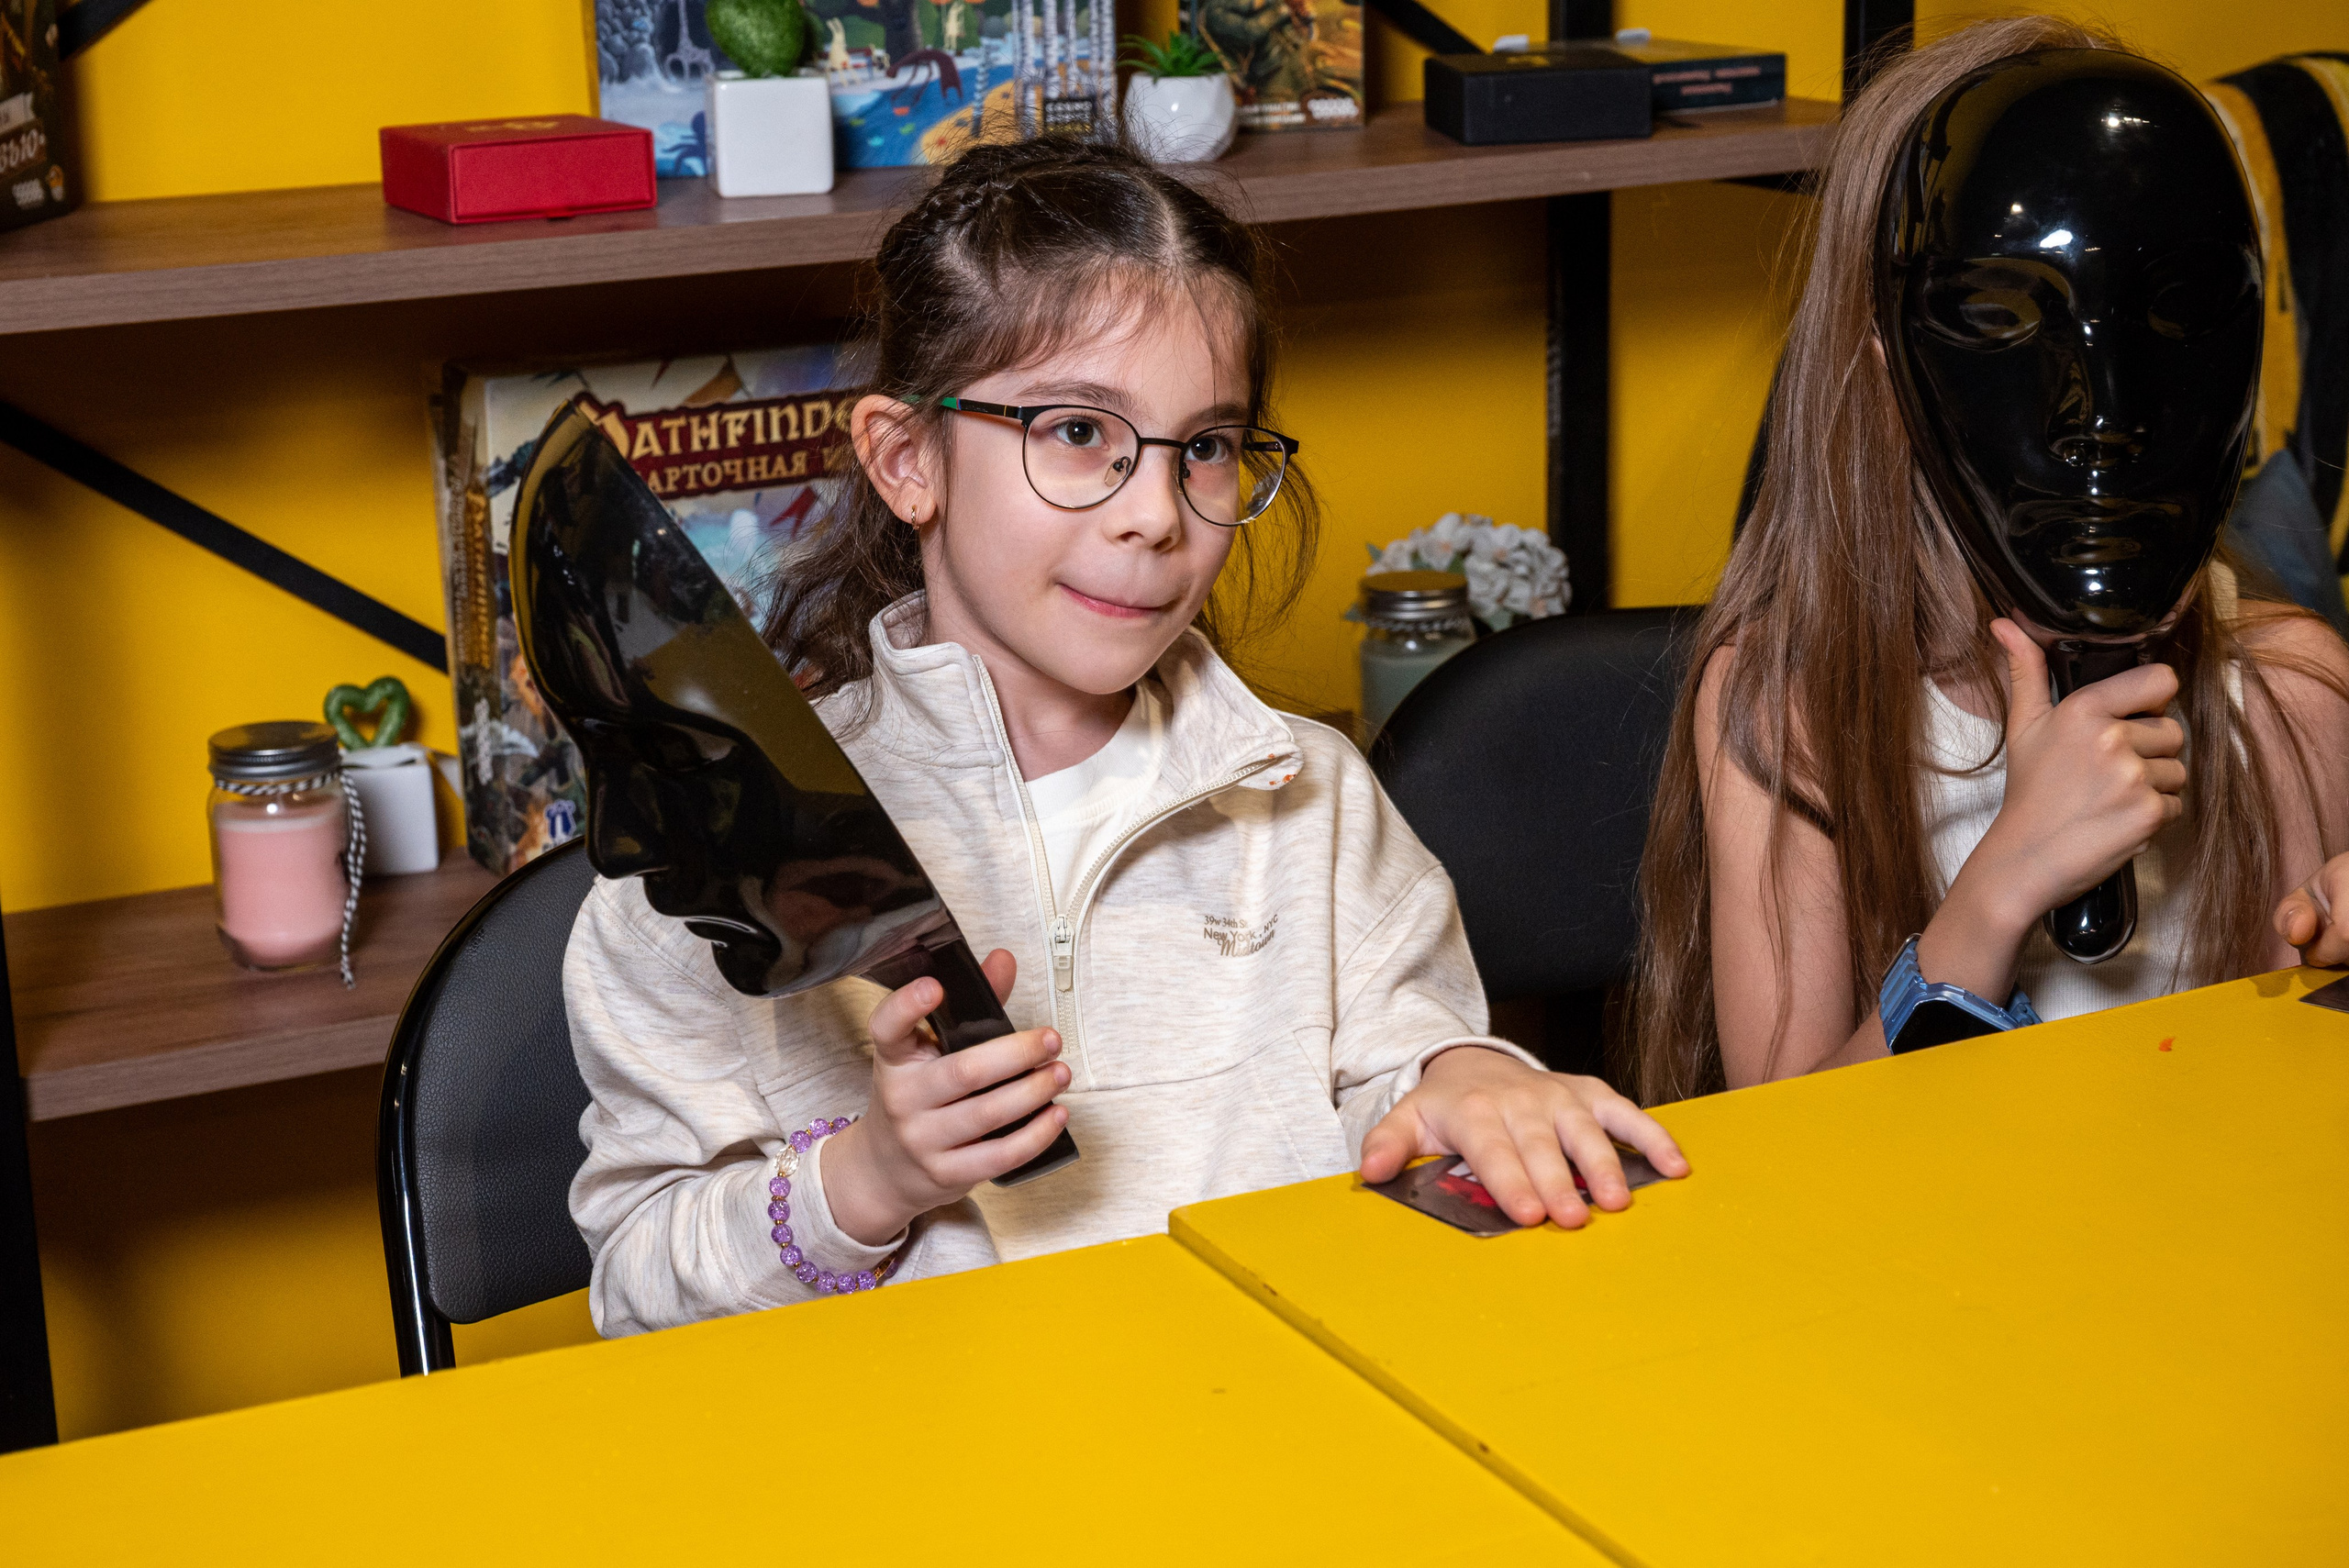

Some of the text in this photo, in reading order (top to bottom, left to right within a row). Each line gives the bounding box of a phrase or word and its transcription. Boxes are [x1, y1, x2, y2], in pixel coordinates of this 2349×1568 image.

[637, 450, 807, 494] АРТОЧНАЯ
[1203, 928, 1228, 940] New
[1264, 914, 1279, 934] NYC
